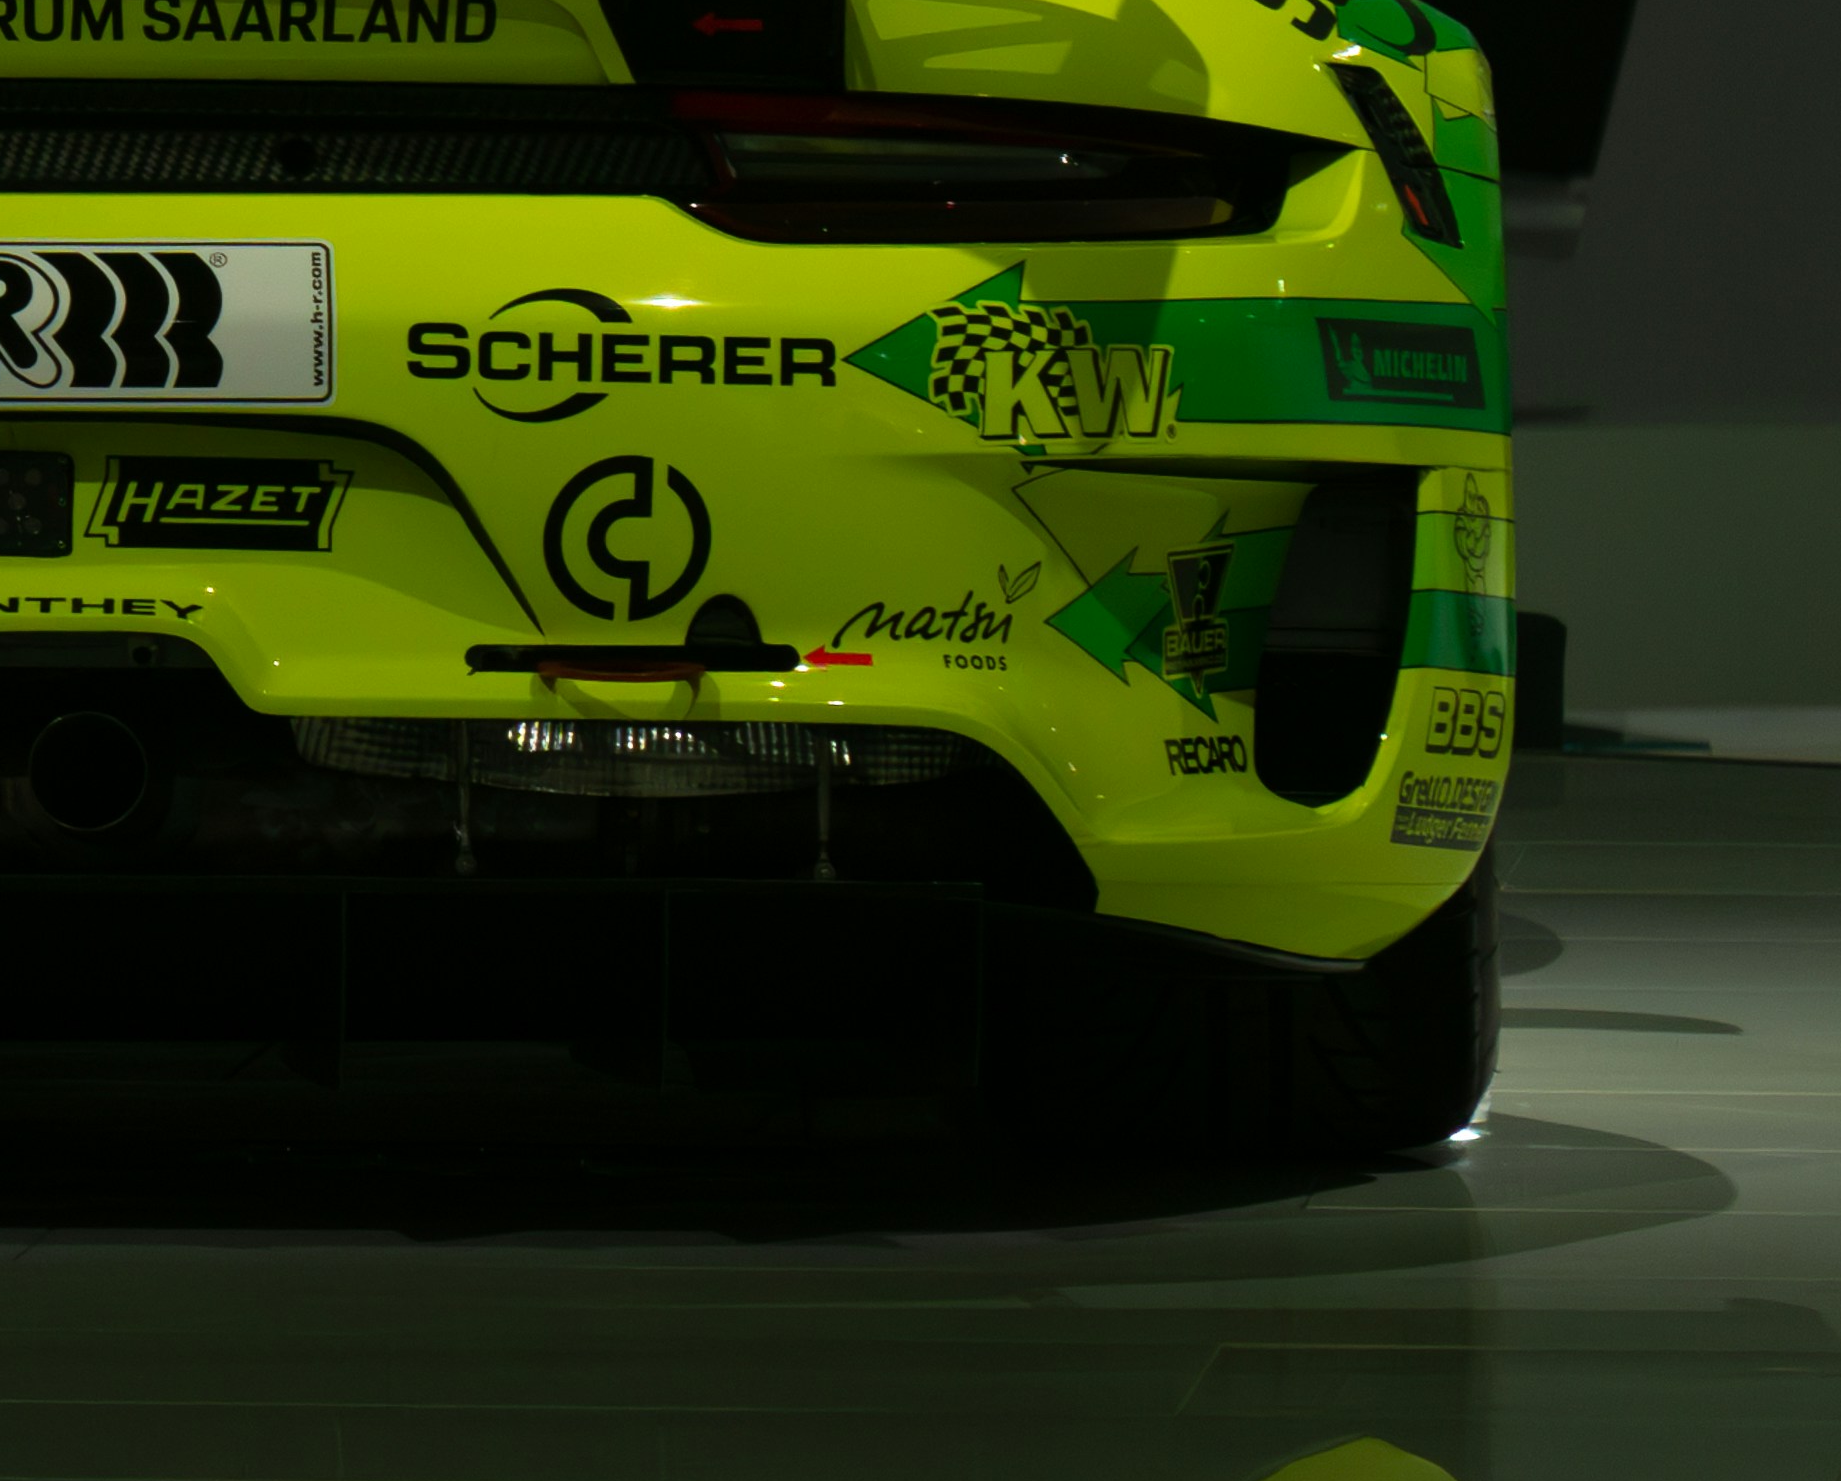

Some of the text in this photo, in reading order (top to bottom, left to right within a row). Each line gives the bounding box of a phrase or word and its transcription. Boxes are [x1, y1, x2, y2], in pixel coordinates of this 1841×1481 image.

[311, 251, 324, 386] www.h-r.com
[408, 323, 836, 387] SCHERER
[1373, 347, 1467, 383] MICHELIN
[117, 481, 322, 526] HAZET
[943, 654, 1008, 672] FOODS
[1167, 627, 1225, 657] BAUER
[1426, 686, 1505, 758] BBS
[1164, 736, 1248, 776] RECARO
